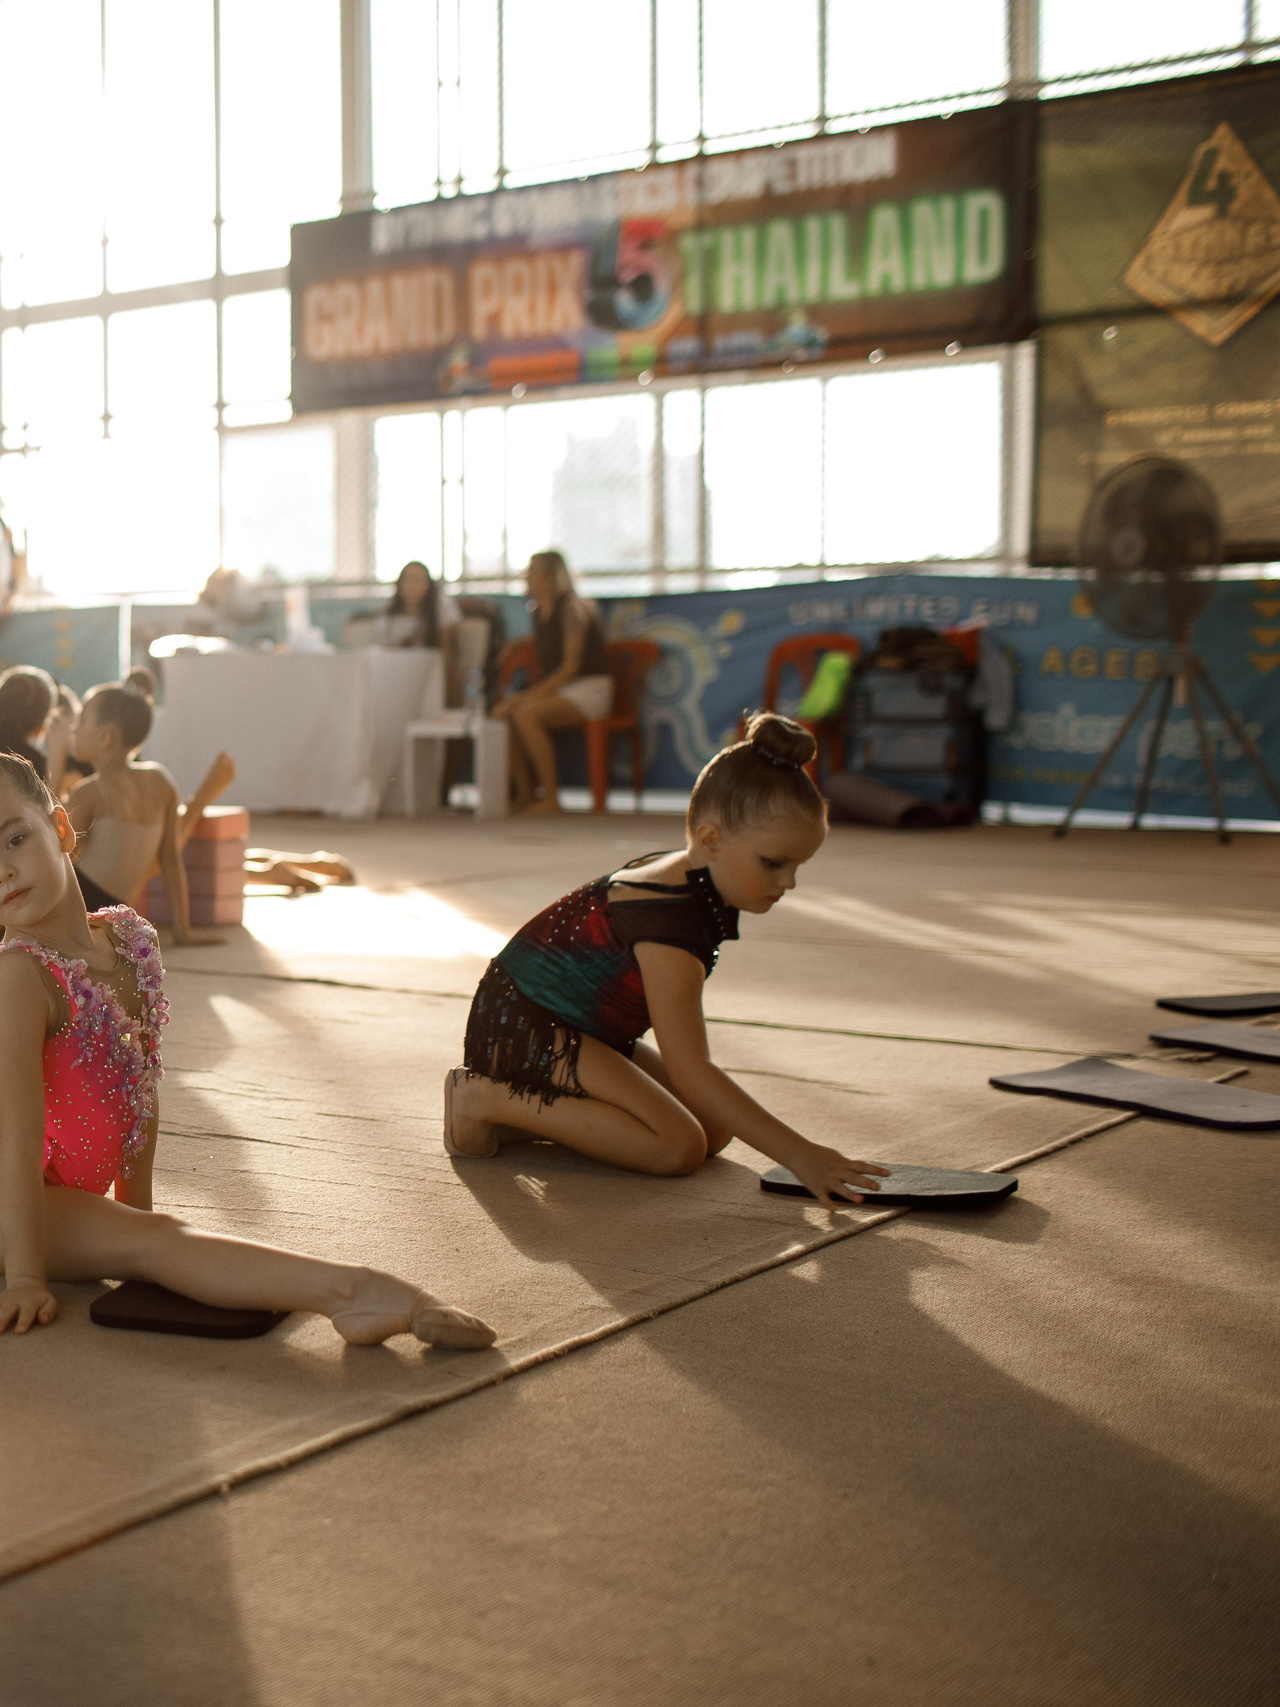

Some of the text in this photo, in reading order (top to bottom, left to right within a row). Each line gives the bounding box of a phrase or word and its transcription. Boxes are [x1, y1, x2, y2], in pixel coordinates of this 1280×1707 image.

[302, 266, 457, 361] GRAND
[469, 247, 587, 342] PRIX
[589, 216, 673, 333] 5
[679, 188, 1007, 317] THAILAND
[1037, 645, 1163, 682] AGES
